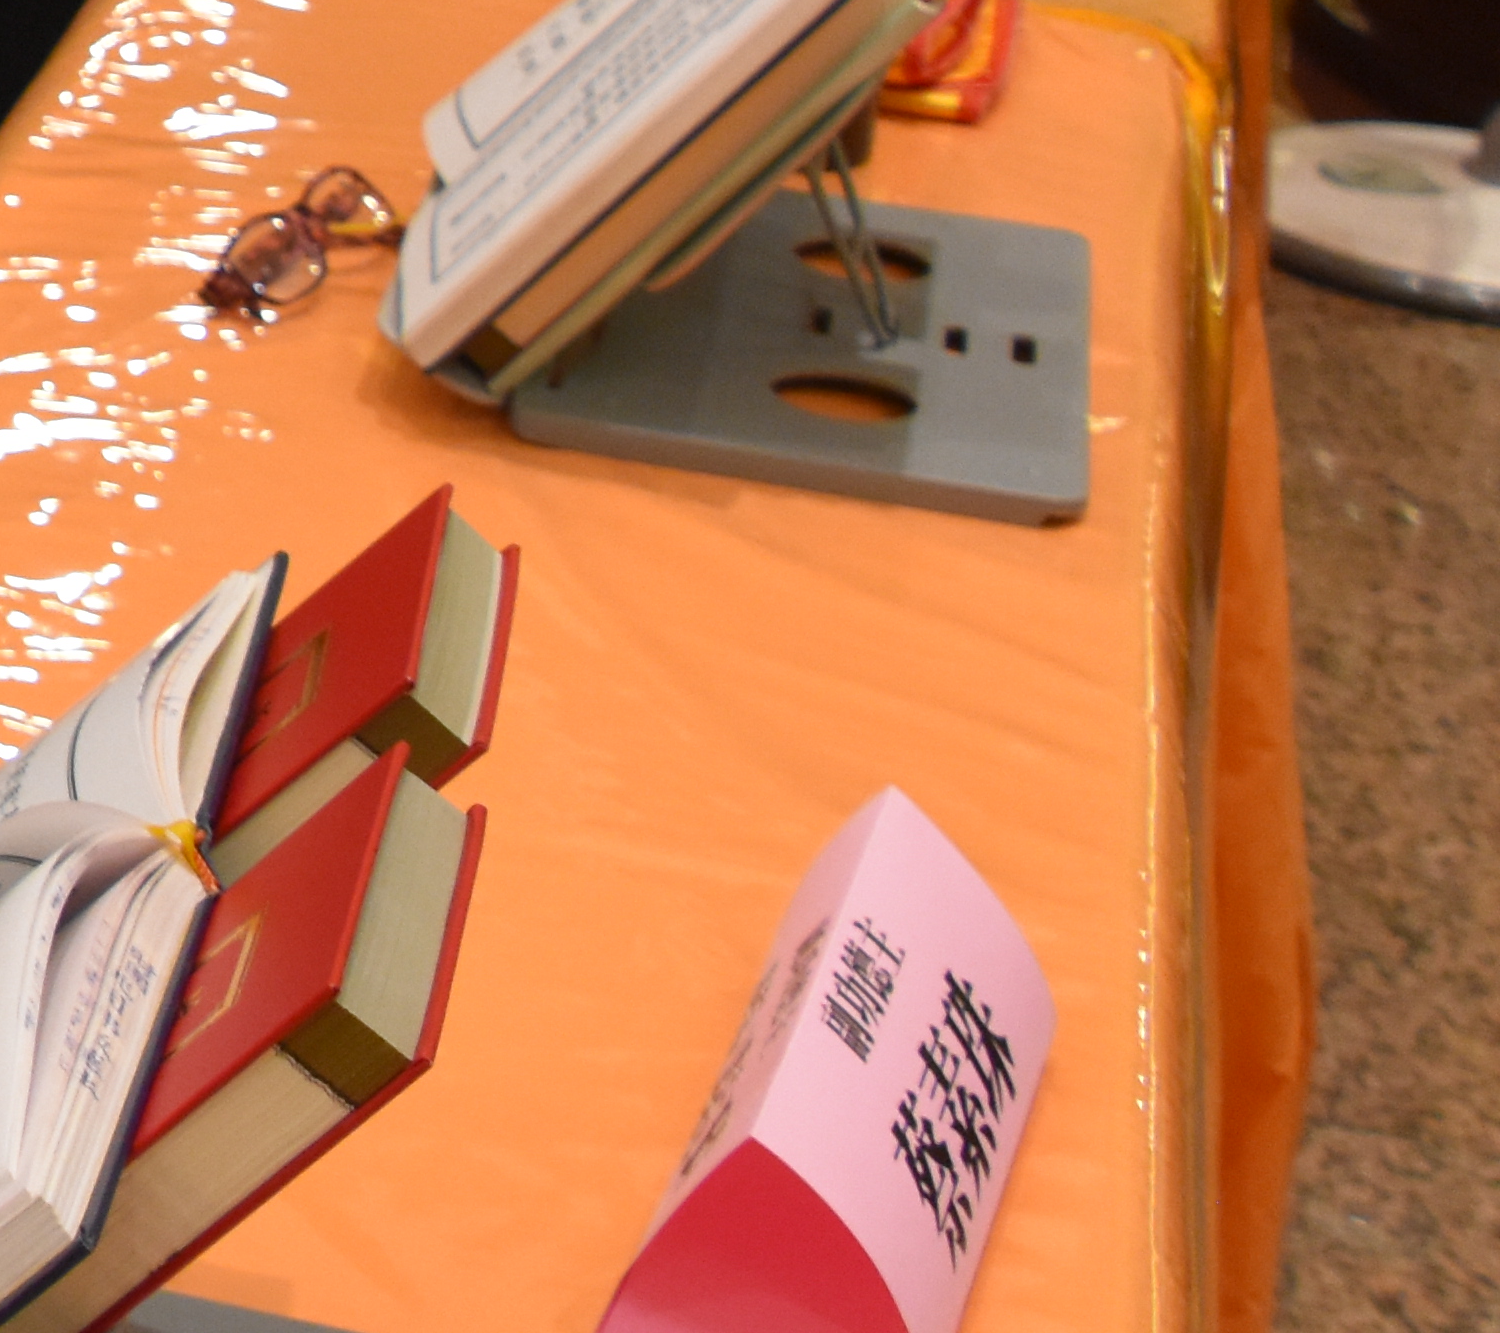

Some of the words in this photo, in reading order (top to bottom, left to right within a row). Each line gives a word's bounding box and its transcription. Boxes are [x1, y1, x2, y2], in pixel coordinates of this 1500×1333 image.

[821, 917, 905, 1063] 副功德主
[890, 969, 1016, 1273] 蔡素珠
